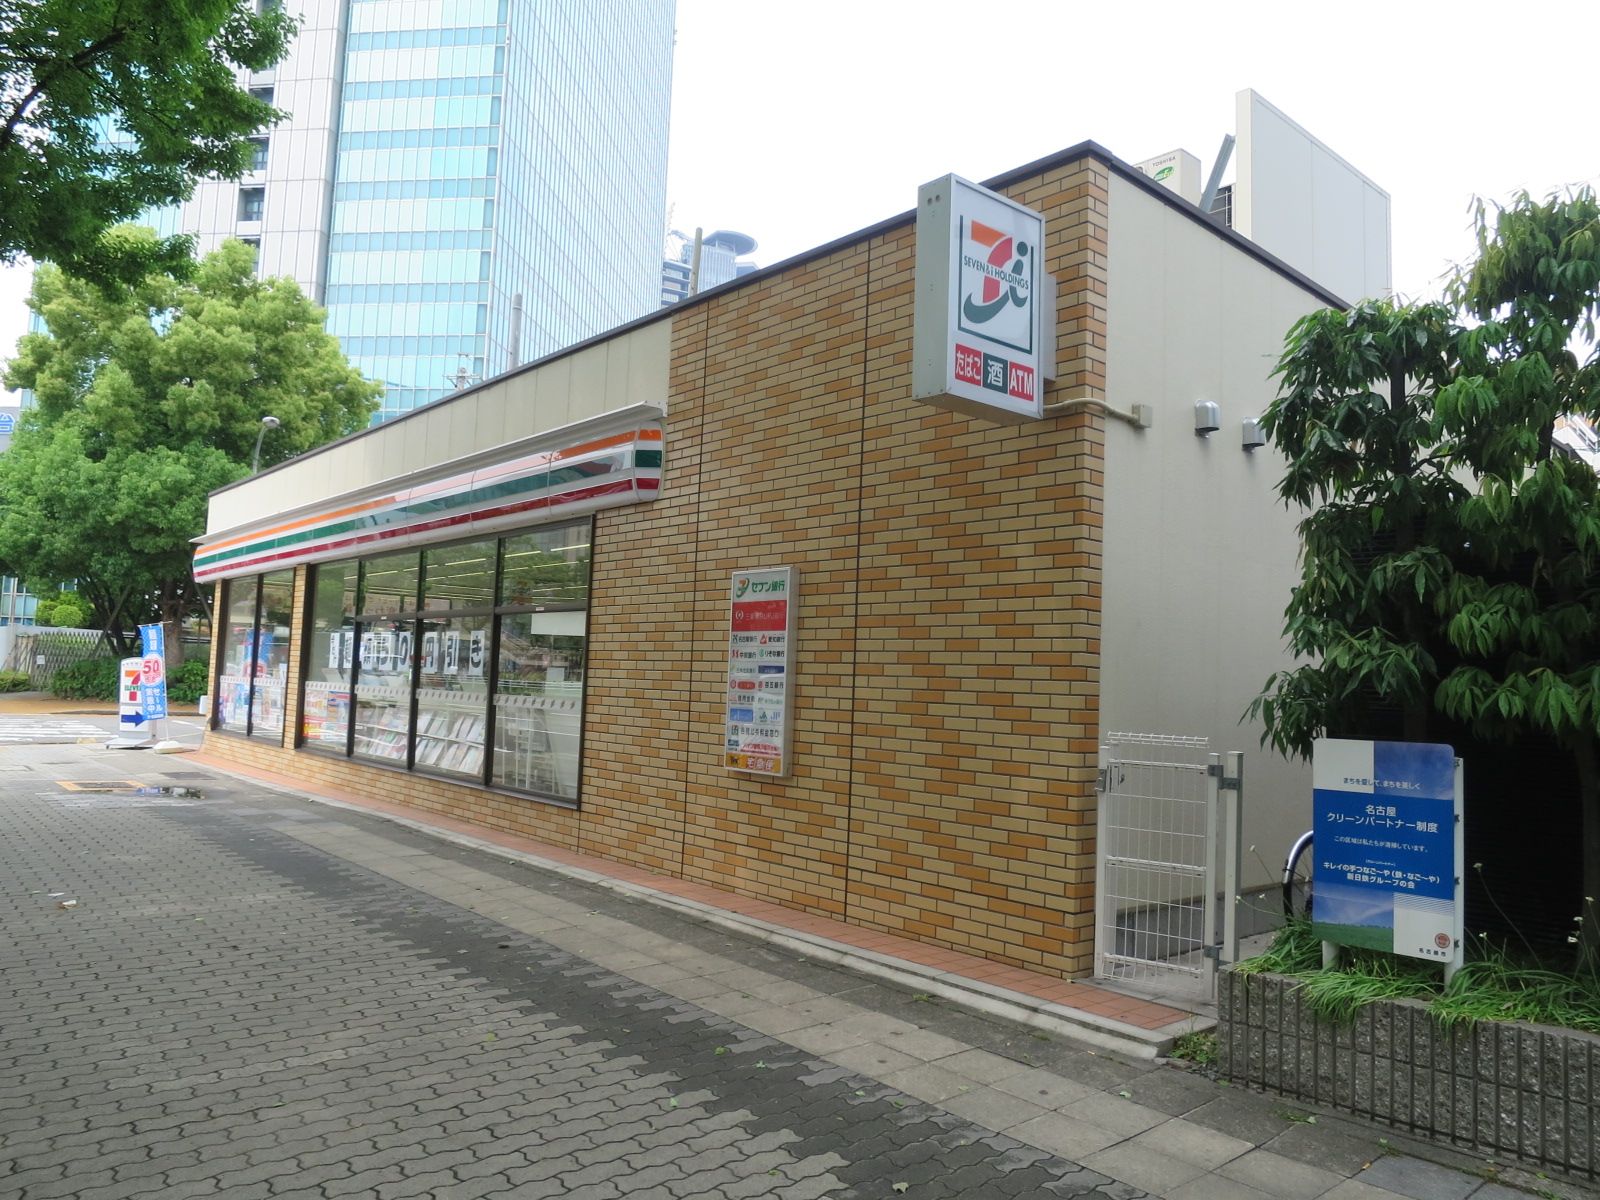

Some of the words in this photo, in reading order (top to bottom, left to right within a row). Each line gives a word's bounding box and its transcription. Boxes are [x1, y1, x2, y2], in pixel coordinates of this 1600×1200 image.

[994, 267, 1029, 290] HOLDINGS
[956, 350, 981, 380] たばこ
[987, 359, 1004, 387] 酒
[1009, 367, 1033, 396] ATM
[751, 579, 785, 593] セブン銀行
[143, 660, 159, 674] 50
[747, 757, 777, 770] 宅急便
[1365, 804, 1397, 817] 名古屋
[1326, 812, 1439, 833] クリーンパートナー制度
[1346, 872, 1416, 890] 新日鉄グループの会
